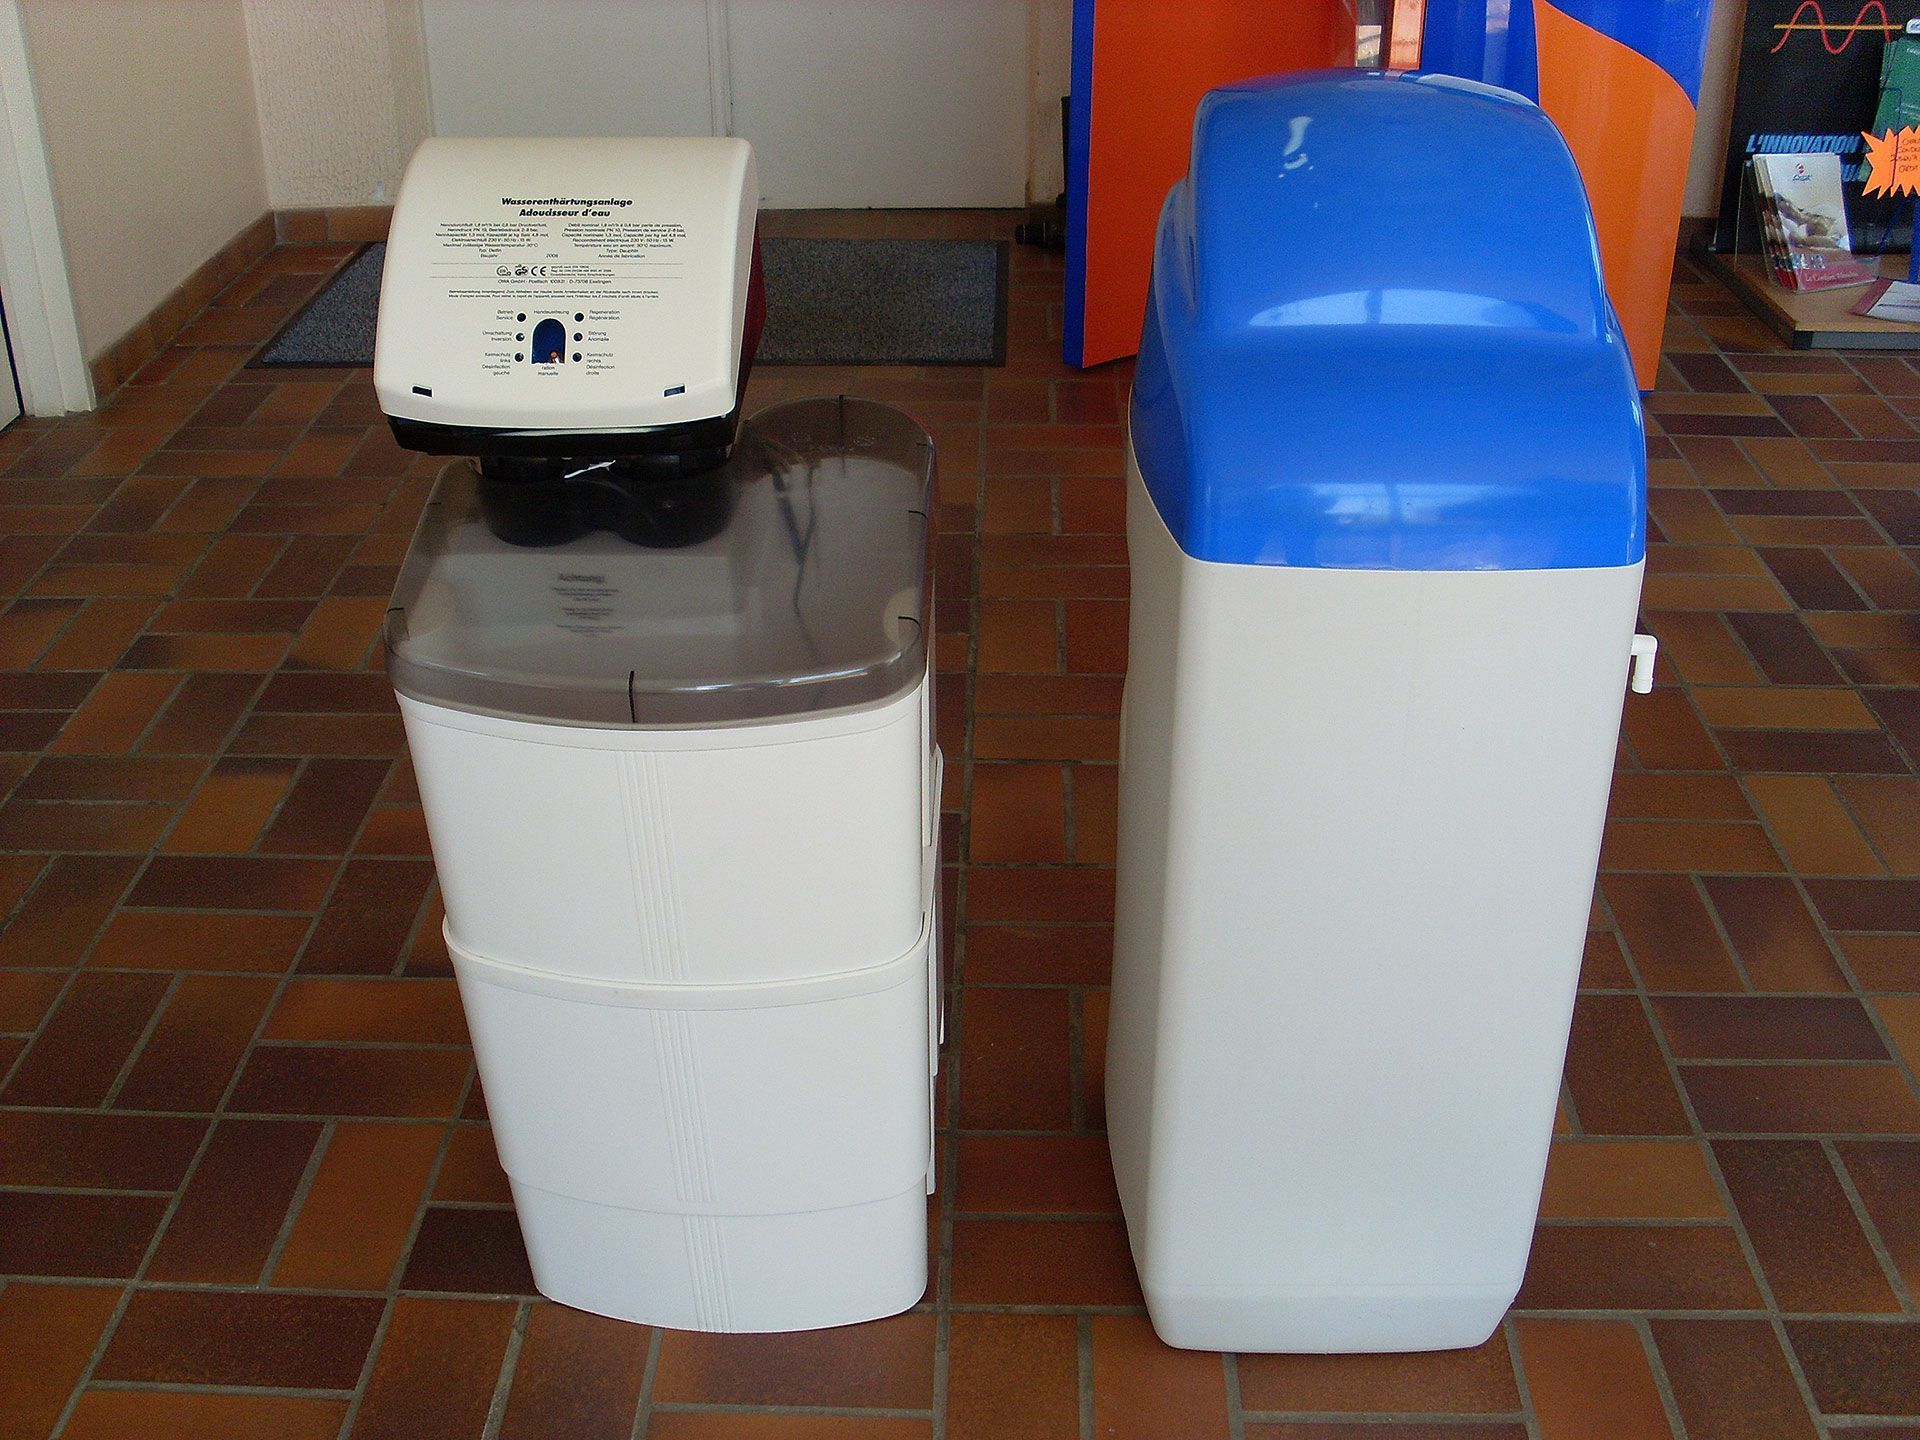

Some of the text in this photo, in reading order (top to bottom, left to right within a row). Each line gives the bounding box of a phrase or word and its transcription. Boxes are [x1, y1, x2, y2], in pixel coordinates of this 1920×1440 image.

[1745, 134, 1860, 153] L'INNOVATION
[501, 197, 633, 208] Wasserenthärtungsanlage
[519, 208, 610, 217] Adoucisseur d'eau
